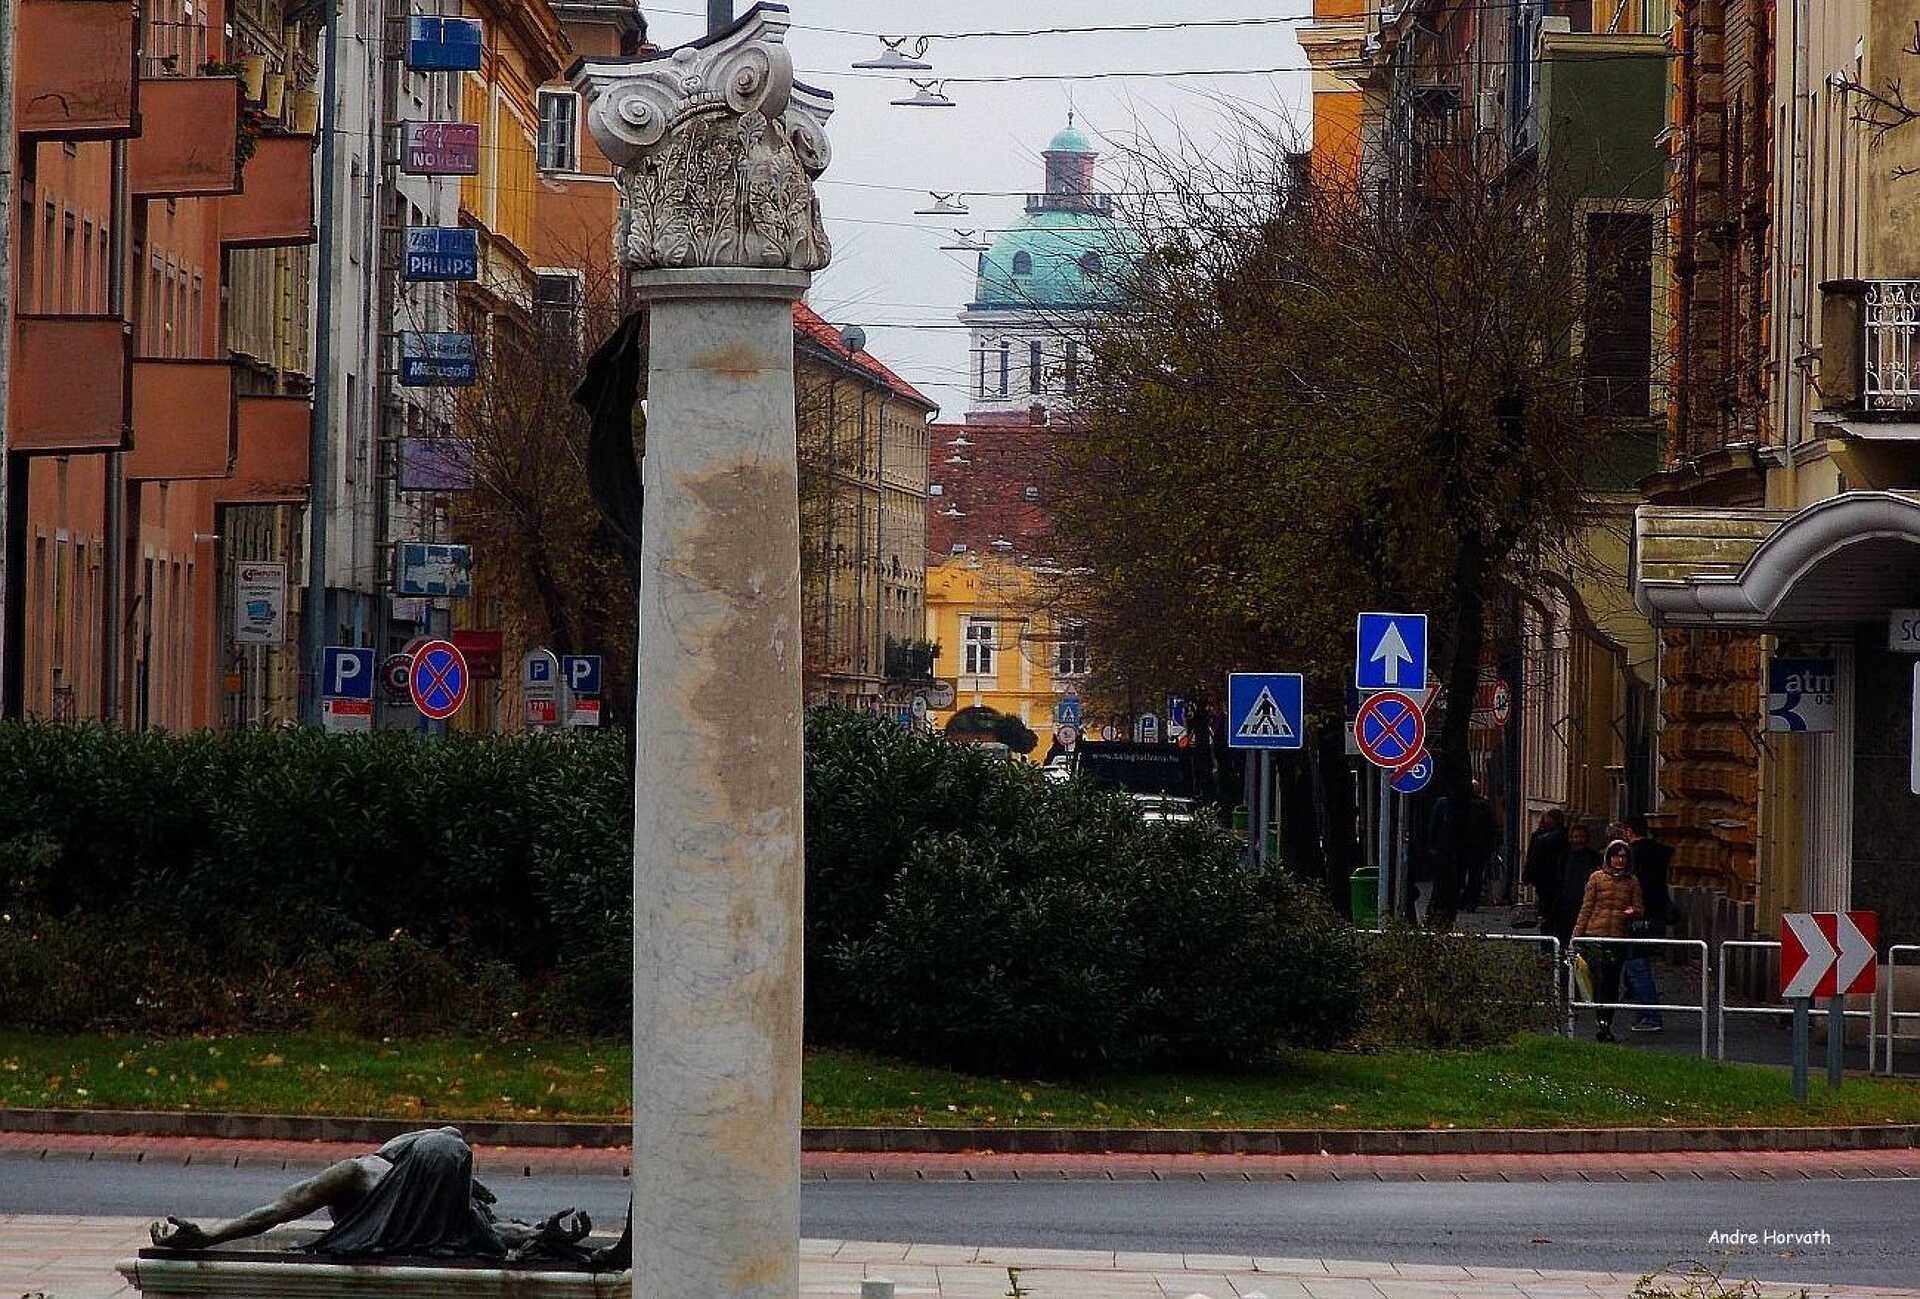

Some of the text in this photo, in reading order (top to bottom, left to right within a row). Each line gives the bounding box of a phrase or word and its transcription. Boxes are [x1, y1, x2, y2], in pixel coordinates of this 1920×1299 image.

[411, 256, 474, 275] PHILIPS
[334, 653, 361, 694] P
[572, 659, 592, 689] P
